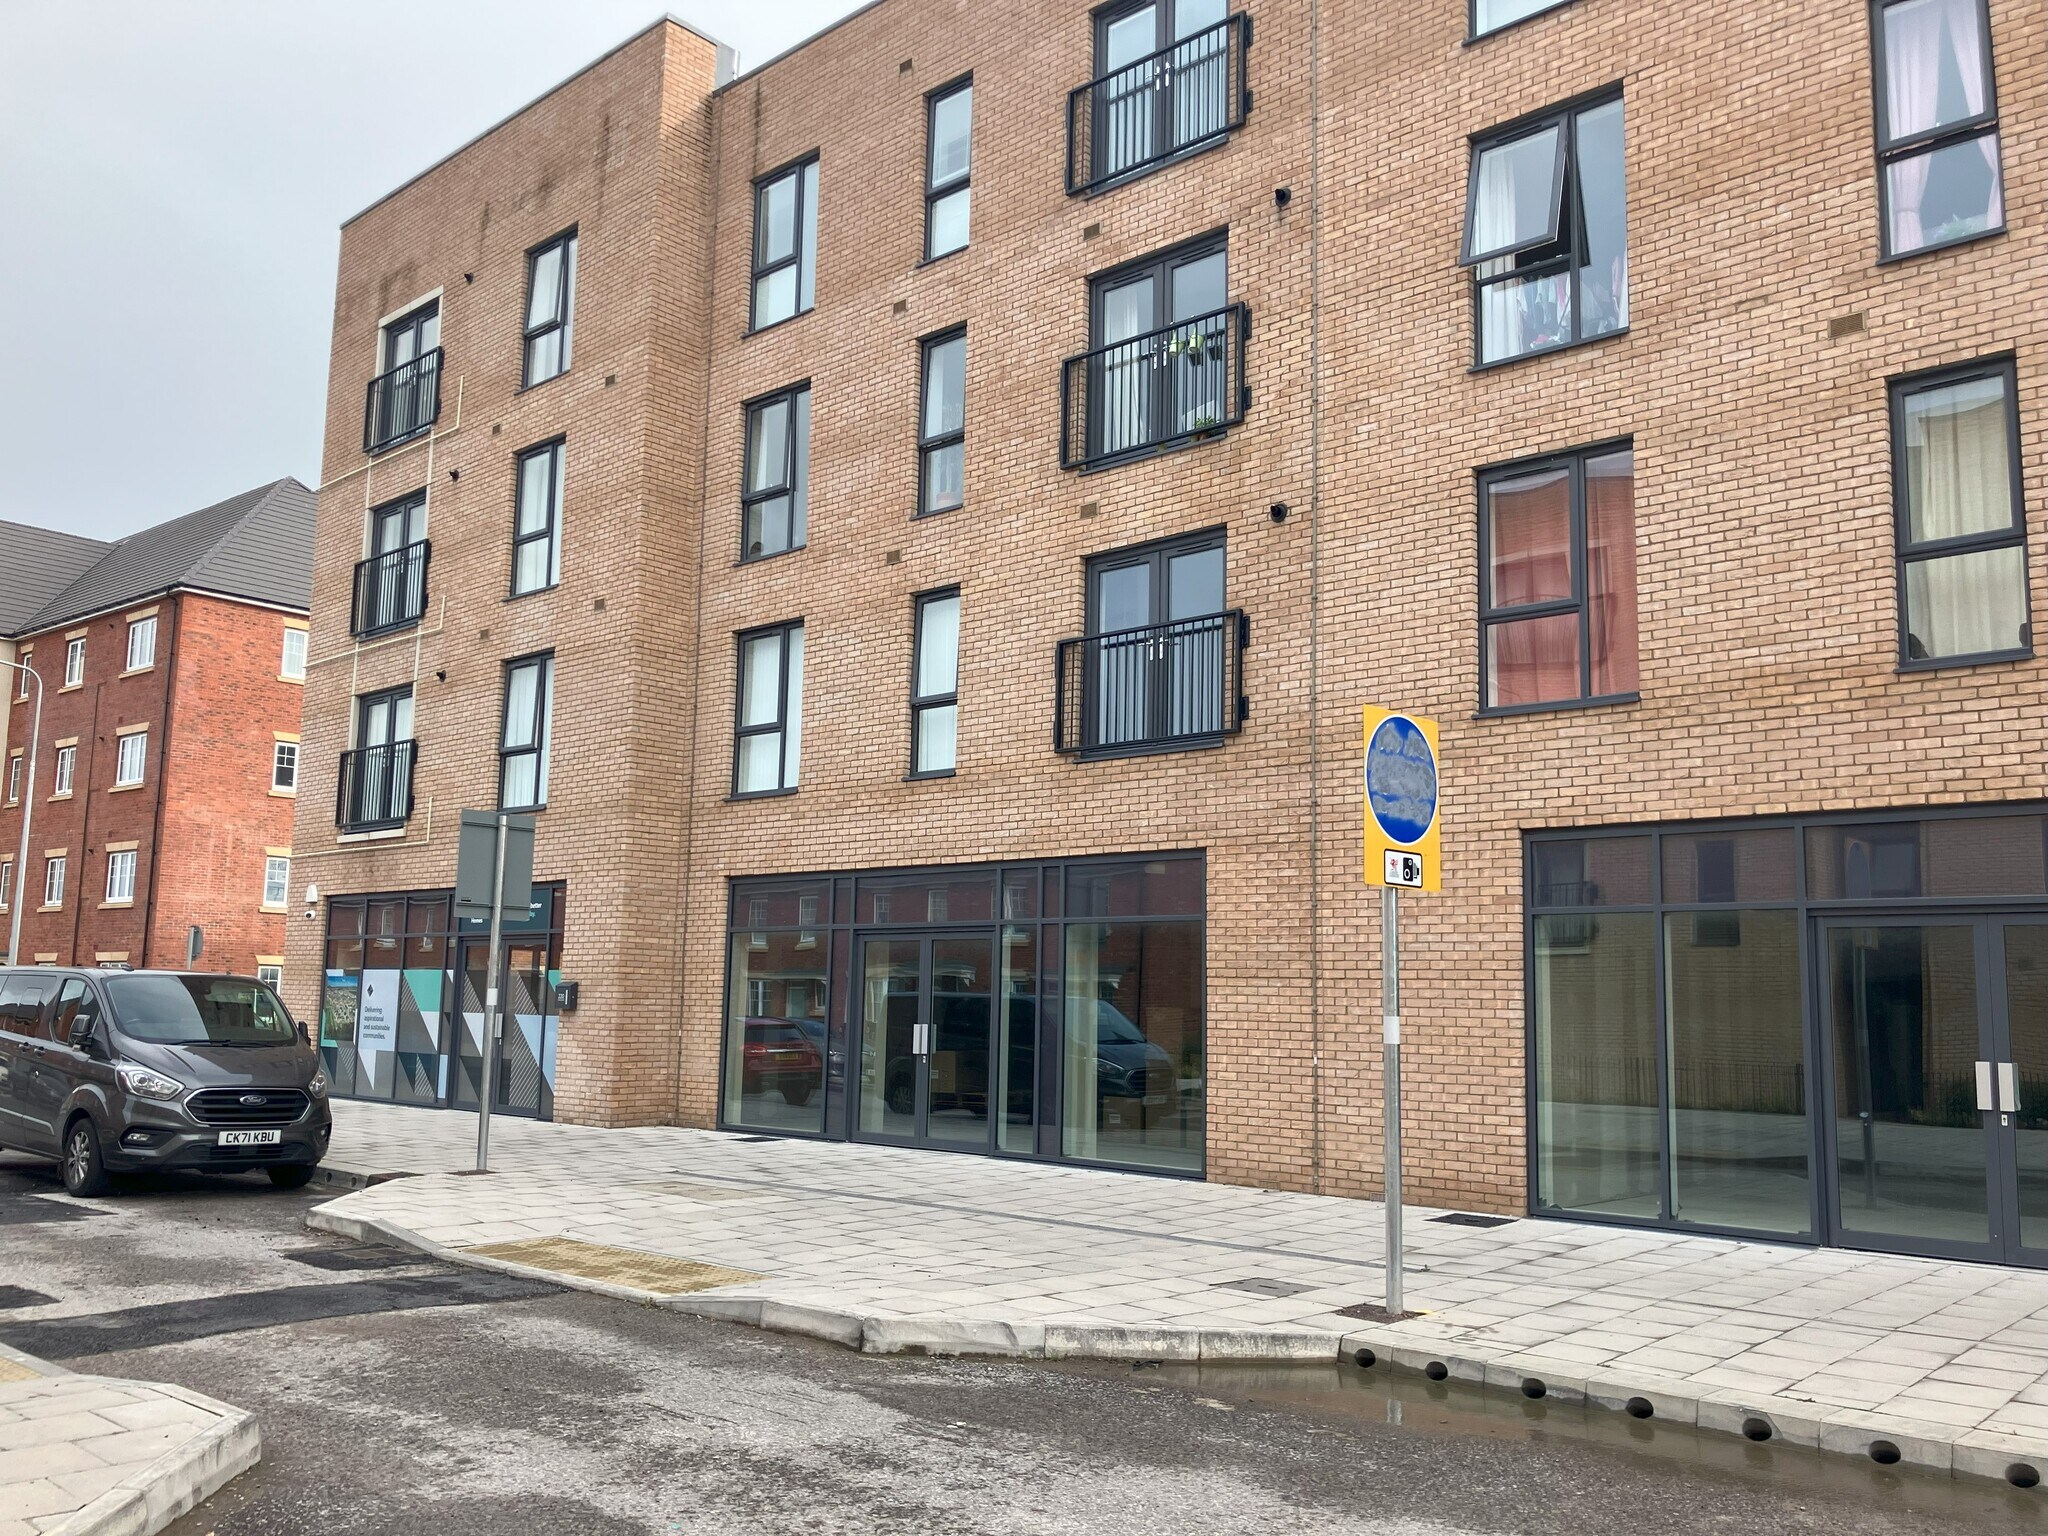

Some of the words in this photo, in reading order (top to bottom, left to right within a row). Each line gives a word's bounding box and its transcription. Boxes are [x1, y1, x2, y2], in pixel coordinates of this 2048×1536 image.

[365, 1006, 382, 1014] Delivering
[226, 1132, 251, 1143] CK71
[253, 1132, 274, 1142] KBU
